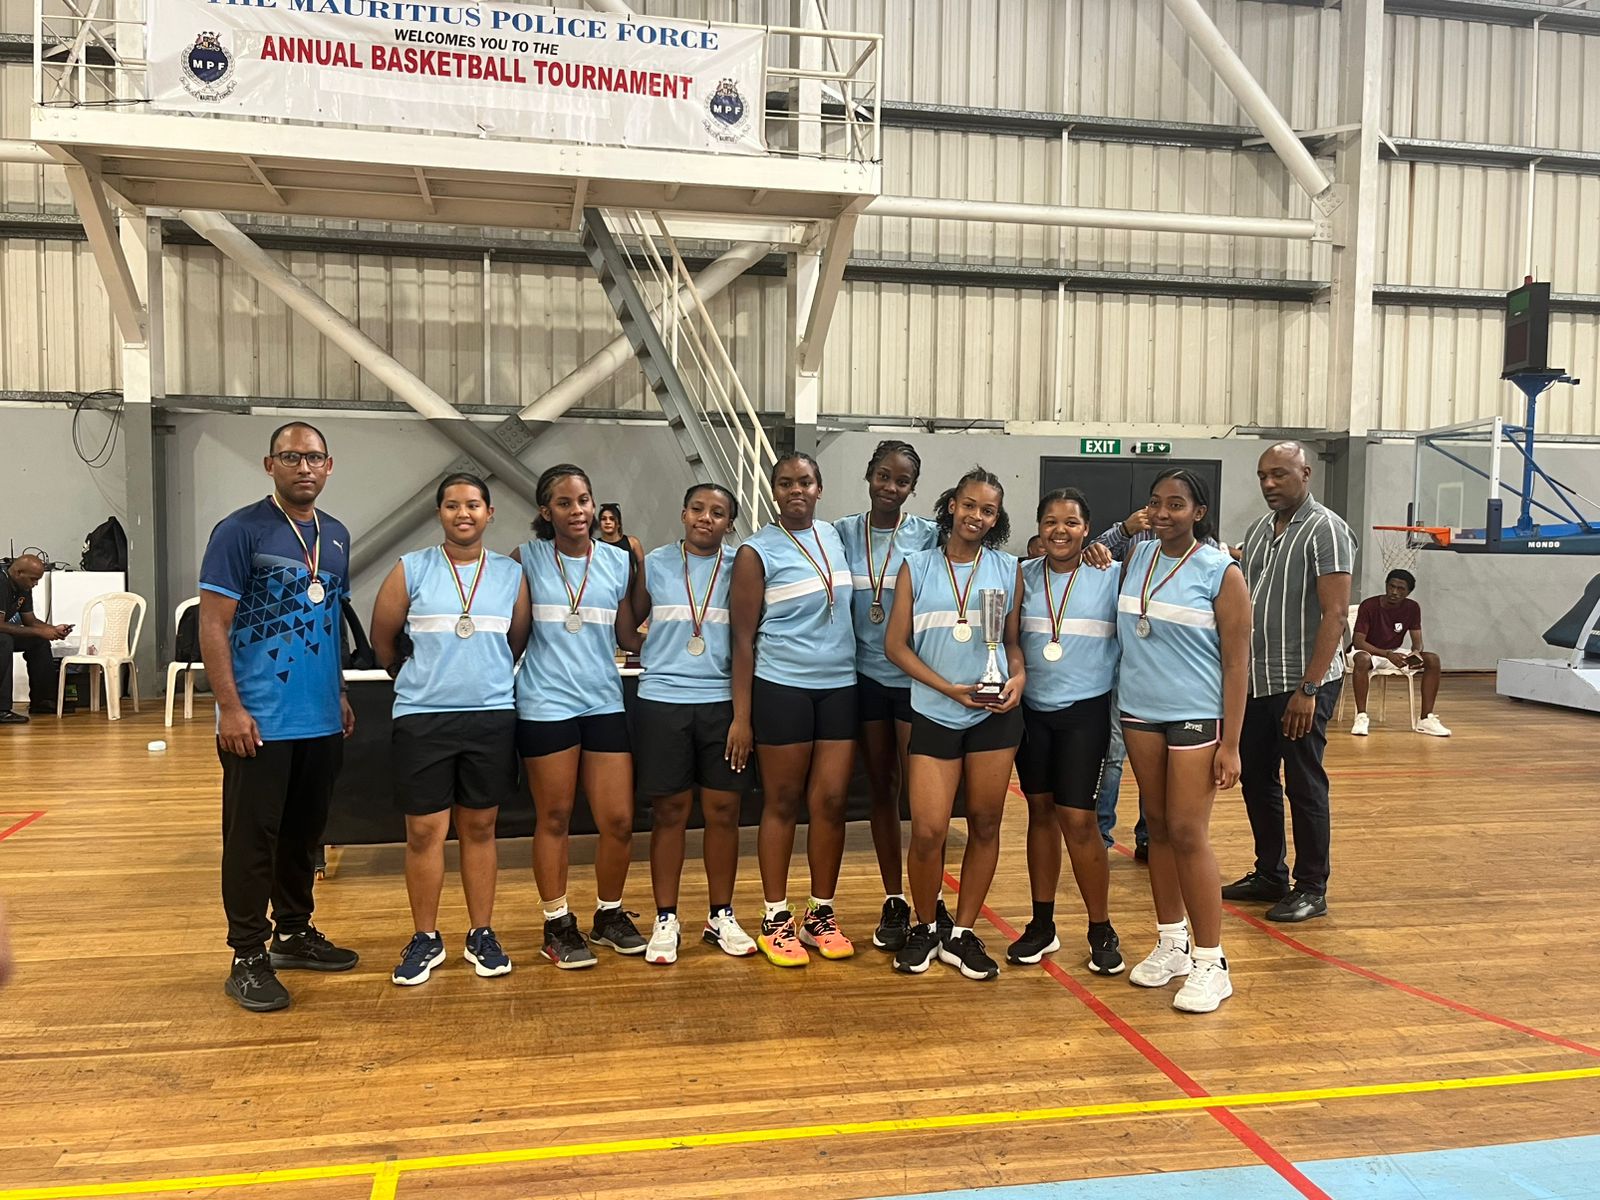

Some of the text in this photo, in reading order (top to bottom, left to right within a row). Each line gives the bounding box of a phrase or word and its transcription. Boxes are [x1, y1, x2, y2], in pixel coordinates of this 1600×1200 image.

[288, 0, 718, 50] MAURITIUS POLICE FORCE
[395, 29, 559, 55] WELCOMES YOU TO THE
[261, 35, 693, 100] ANNUAL BASKETBALL TOURNAMENT
[1085, 441, 1115, 453] EXIT
